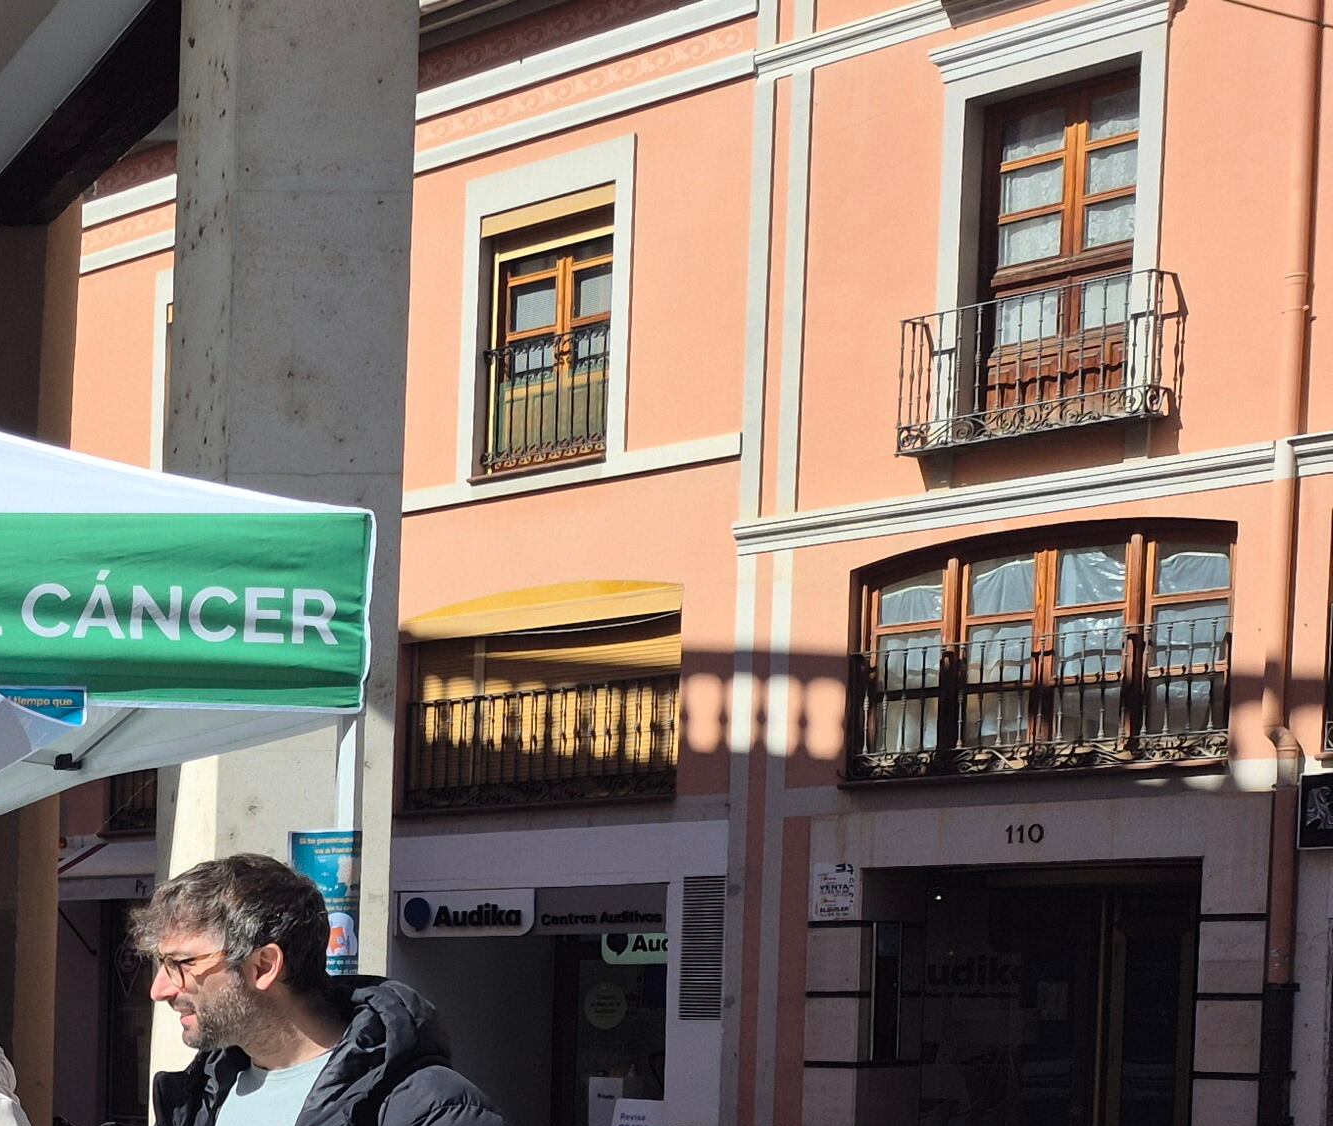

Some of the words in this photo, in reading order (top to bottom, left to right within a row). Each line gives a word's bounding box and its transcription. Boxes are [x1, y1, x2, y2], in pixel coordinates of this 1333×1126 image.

[20, 569, 339, 645] CÁNCER
[13, 697, 51, 708] tiempo
[52, 698, 74, 708] que
[1005, 823, 1045, 844] 110
[433, 902, 522, 928] Audika
[540, 912, 597, 927] Centros
[599, 911, 663, 925] Auditivos
